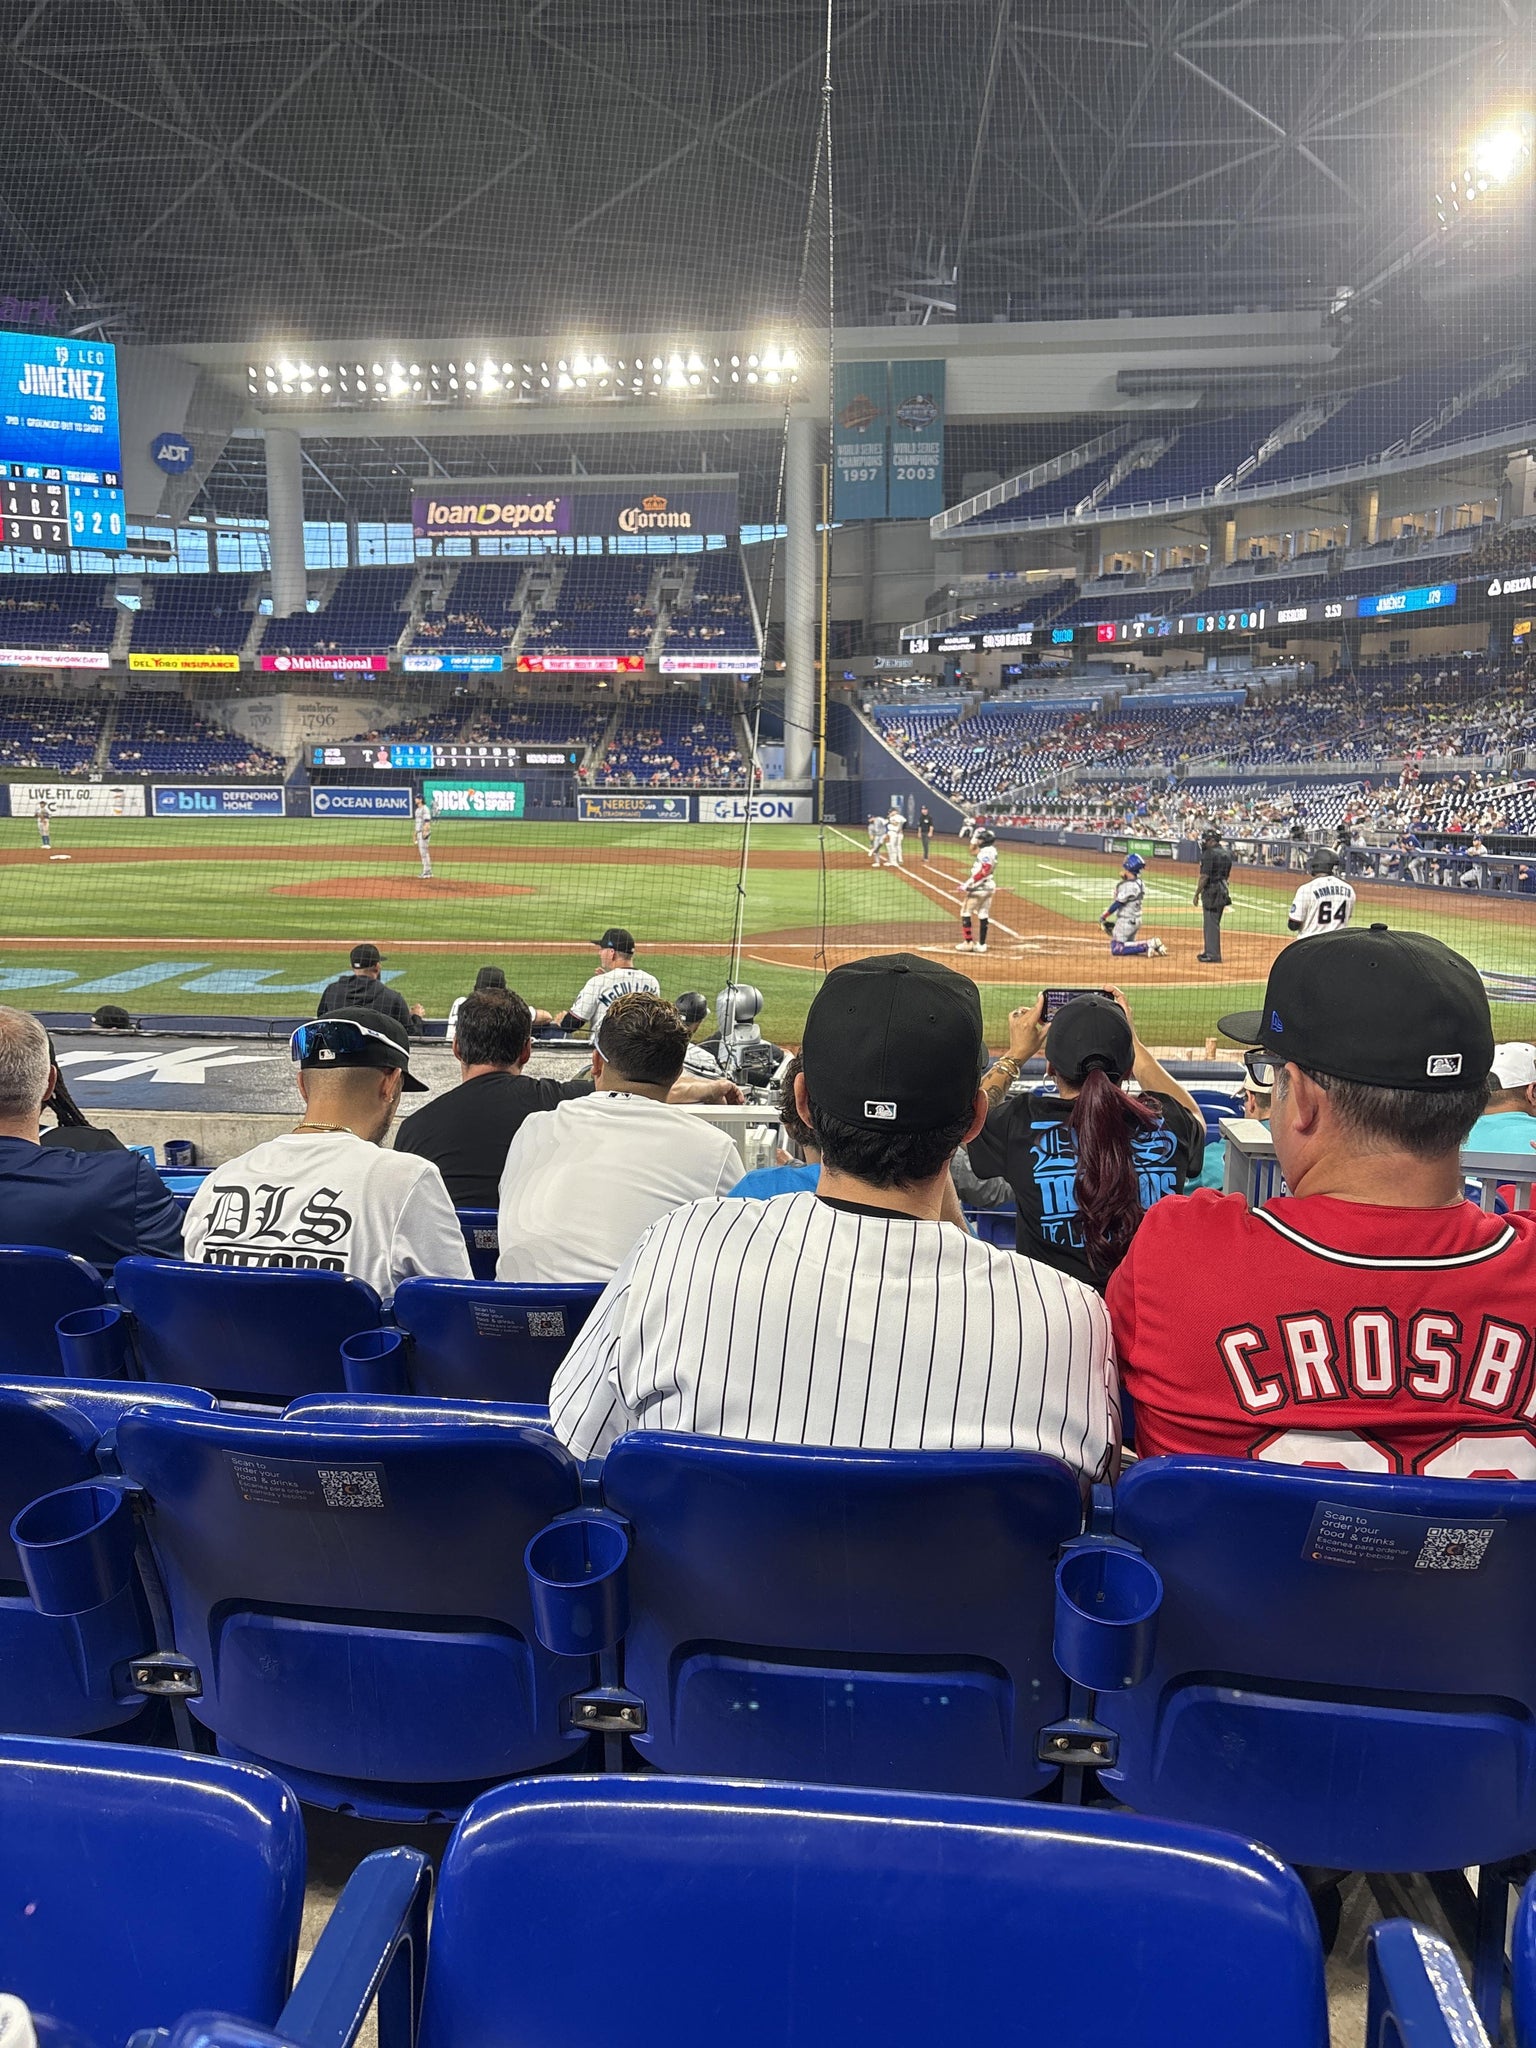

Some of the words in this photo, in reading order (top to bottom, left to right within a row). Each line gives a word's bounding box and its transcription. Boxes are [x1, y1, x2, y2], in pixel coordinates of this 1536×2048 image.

[79, 350, 104, 364] LEO
[157, 445, 189, 461] ADT
[843, 468, 878, 481] 1997
[897, 467, 936, 480] 2003
[9, 498, 18, 514] 4
[31, 498, 40, 515] 0
[50, 499, 60, 516] 2
[427, 500, 556, 528] loanDepot
[73, 510, 85, 533] 3
[92, 512, 103, 534] 2
[109, 513, 121, 535] 0
[618, 507, 692, 534] Corona
[10, 522, 20, 538] 3
[32, 523, 42, 541] 0
[52, 525, 62, 542] 2
[1503, 577, 1531, 595] DELTA
[1206, 616, 1215, 632] 3
[1227, 614, 1236, 630] 2
[1324, 604, 1342, 618] 3.53
[291, 657, 372, 670] Multinational
[300, 714, 335, 730] 1796
[362, 750, 373, 762] T
[29, 789, 55, 800] LIVE.
[57, 790, 75, 800] FIT.
[77, 790, 93, 800] GO.
[179, 792, 216, 810] blu
[223, 792, 278, 801] DEFENDING
[223, 802, 253, 810] HOME
[332, 797, 371, 808] OCEAN
[376, 798, 408, 809] BANK
[734, 802, 793, 818] LEON
[1318, 900, 1347, 924] 64
[204, 1183, 353, 1246] DLS
[1215, 1305, 1536, 1420] CROSB
[232, 1457, 255, 1468] Scan
[234, 1465, 257, 1475] order
[259, 1469, 280, 1477] your
[236, 1472, 257, 1482] food
[270, 1479, 299, 1488] drinks
[1324, 1510, 1353, 1522] Scan
[1356, 1516, 1367, 1525] to
[1321, 1520, 1353, 1530] order
[1354, 1526, 1380, 1535] your
[1319, 1528, 1345, 1539] food
[1361, 1536, 1395, 1546] drinks
[1316, 1536, 1353, 1548] Escanea
[1354, 1544, 1375, 1552] para
[1375, 1547, 1409, 1555] ordenar
[1325, 1546, 1357, 1556] comida
[1366, 1553, 1395, 1561] bebida
